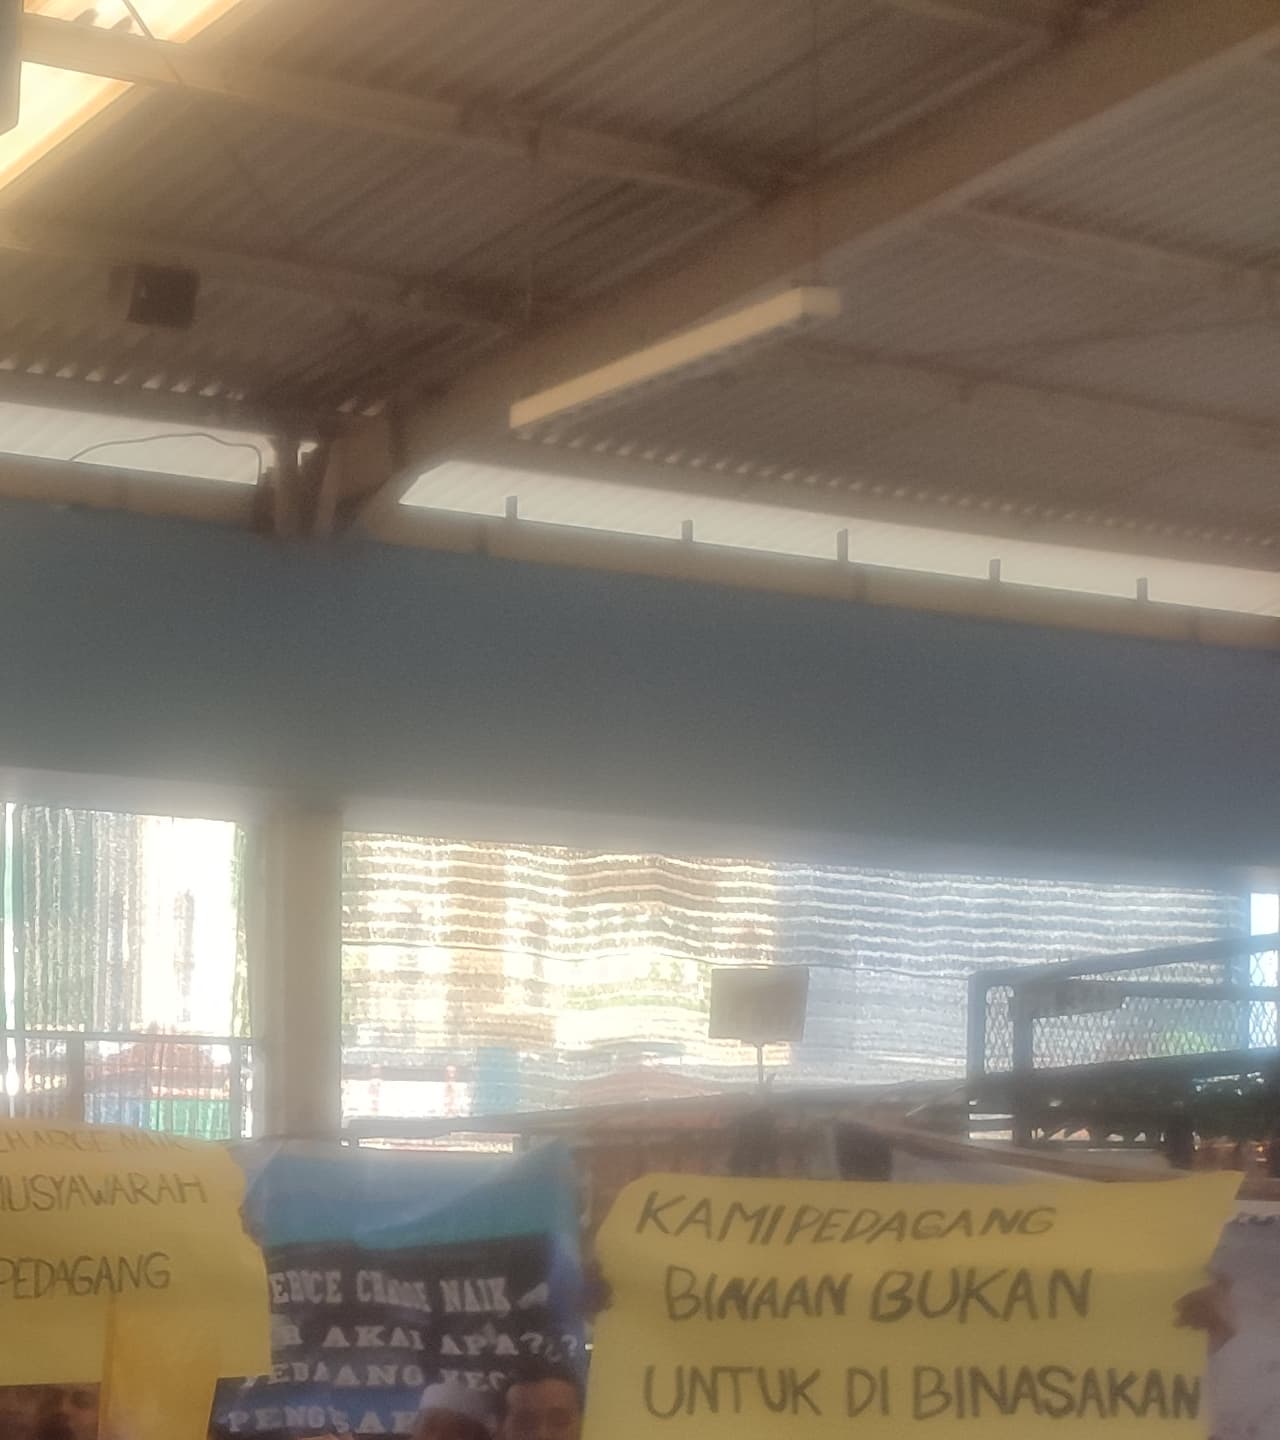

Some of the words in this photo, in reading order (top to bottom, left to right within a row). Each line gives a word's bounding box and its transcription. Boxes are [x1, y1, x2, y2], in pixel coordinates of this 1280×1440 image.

[635, 1190, 780, 1245] KAMI
[784, 1206, 1056, 1245] PEDAGANG
[664, 1265, 852, 1323] BINAAN
[870, 1267, 1092, 1324] BUKAN
[643, 1363, 823, 1419] UNTUK
[846, 1366, 890, 1418] DI
[913, 1364, 1201, 1421] BINASAKAN
